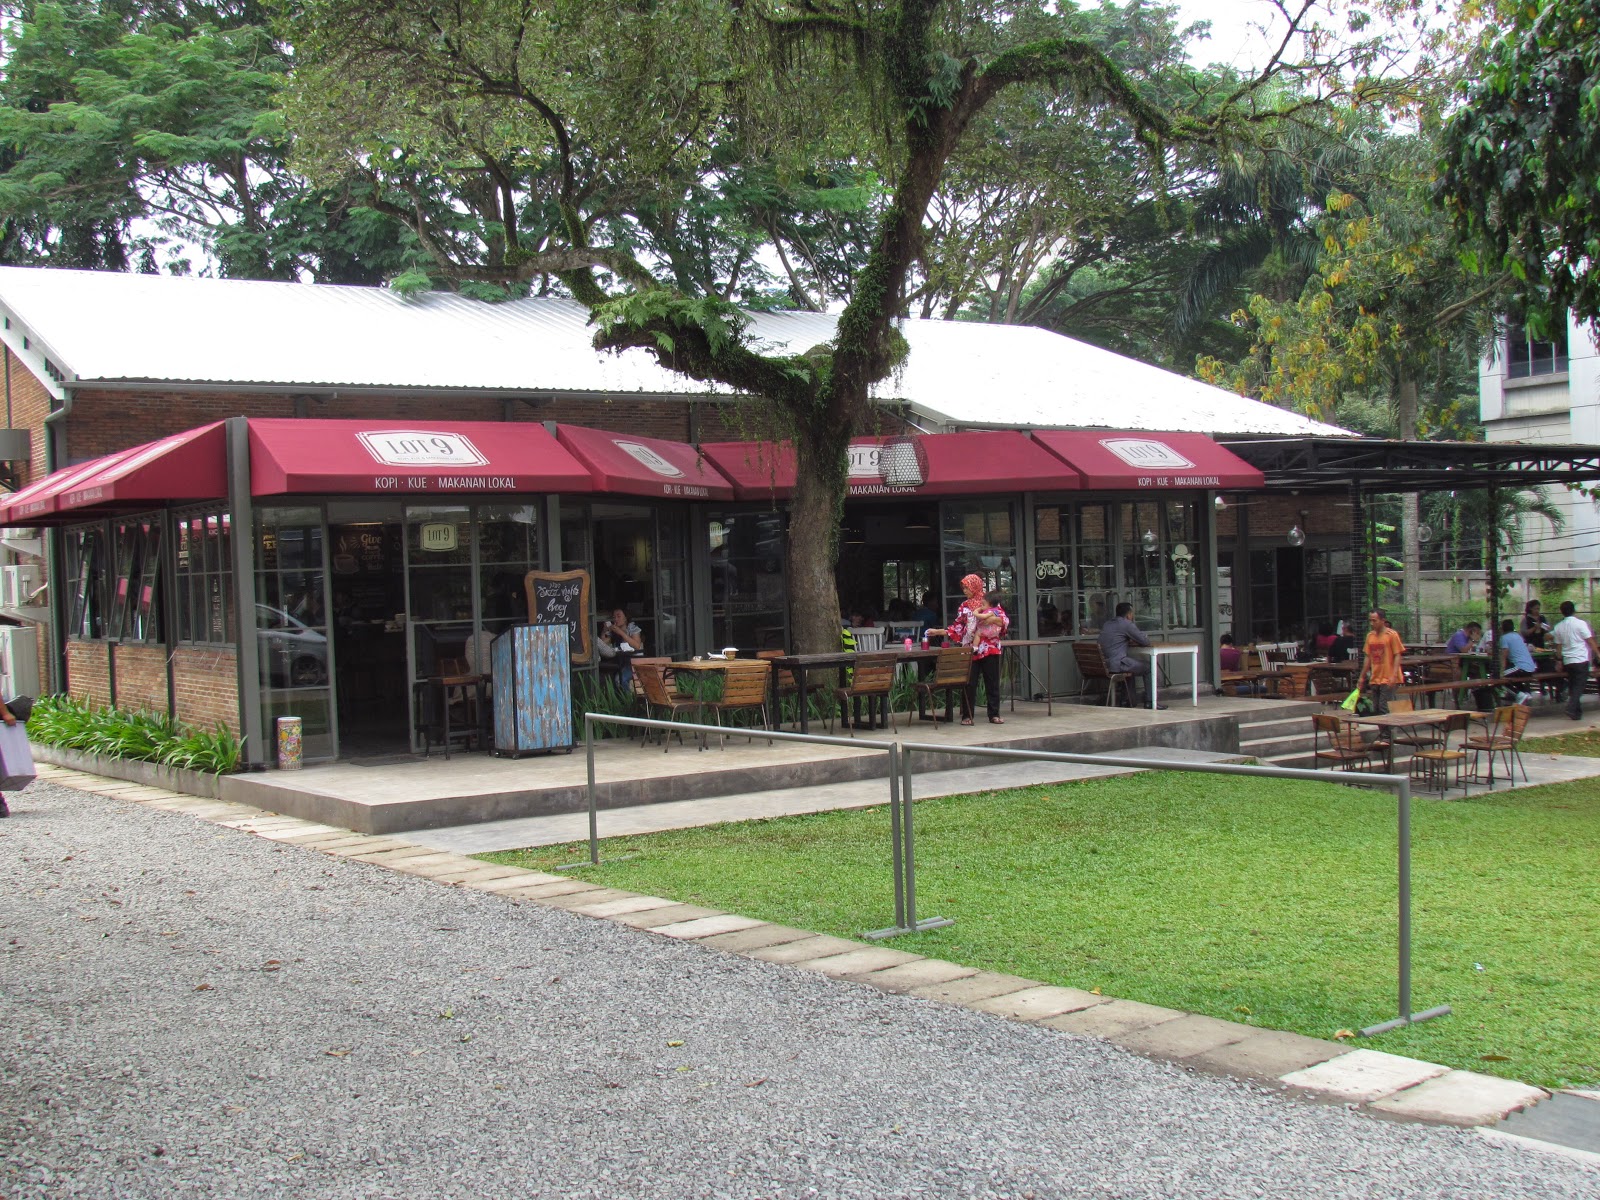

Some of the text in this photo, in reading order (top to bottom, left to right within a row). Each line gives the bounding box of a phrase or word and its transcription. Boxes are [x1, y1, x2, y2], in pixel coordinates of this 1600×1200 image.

[385, 437, 454, 456] LOT 9
[1145, 444, 1168, 459] 9
[869, 450, 882, 467] 9
[375, 477, 516, 489] KOPI KUE MAKANAN LOKAL
[1137, 476, 1220, 487] KOPI KUE MAKANAN LOKAL
[849, 485, 890, 495] MAKANAN
[428, 526, 450, 542] LOT 9
